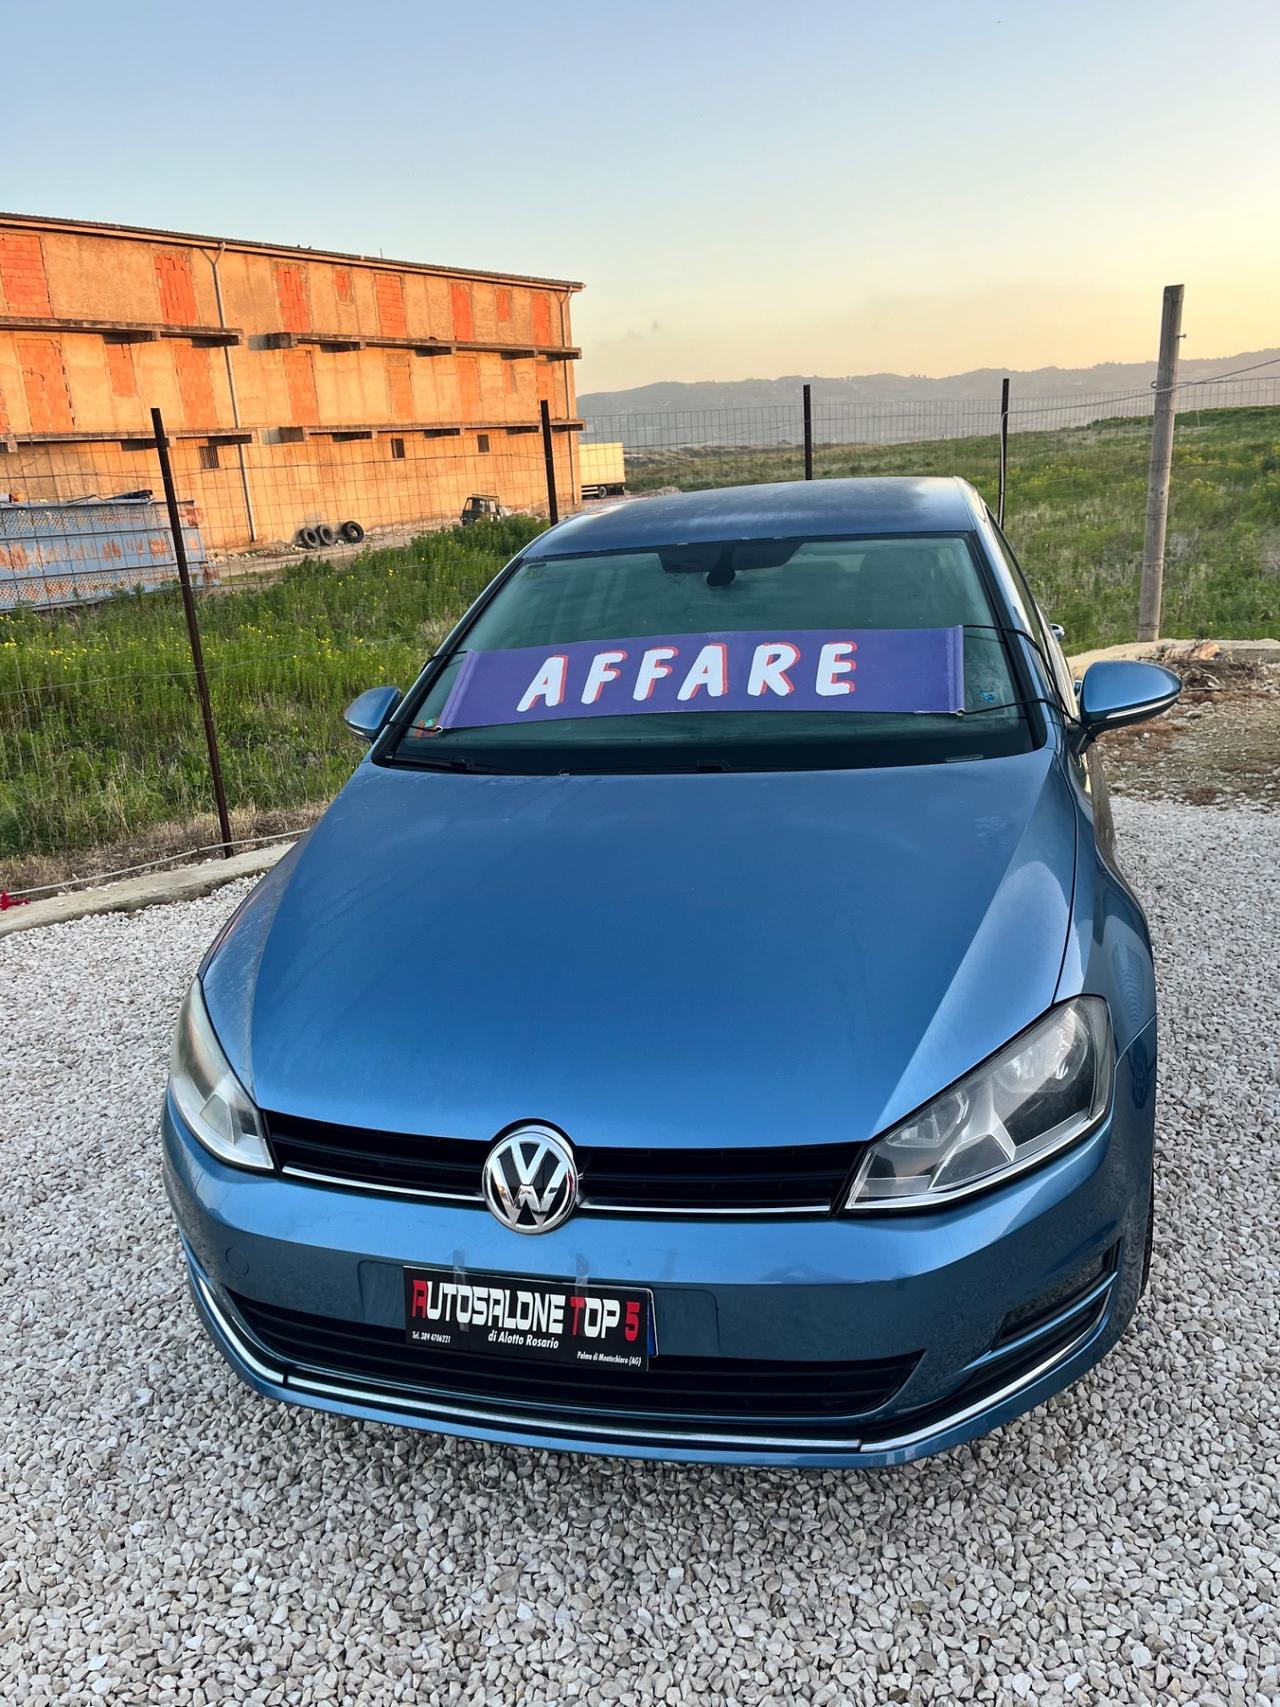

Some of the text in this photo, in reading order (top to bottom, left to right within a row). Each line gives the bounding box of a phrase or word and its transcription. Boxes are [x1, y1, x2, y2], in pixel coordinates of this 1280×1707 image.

[516, 642, 857, 712] AFFARE
[485, 1130, 575, 1231] VW
[412, 1279, 641, 1342] AUTOSALONE TOP 5
[487, 1329, 559, 1349] di Alotto Rosario
[628, 1355, 642, 1367] (AG)
